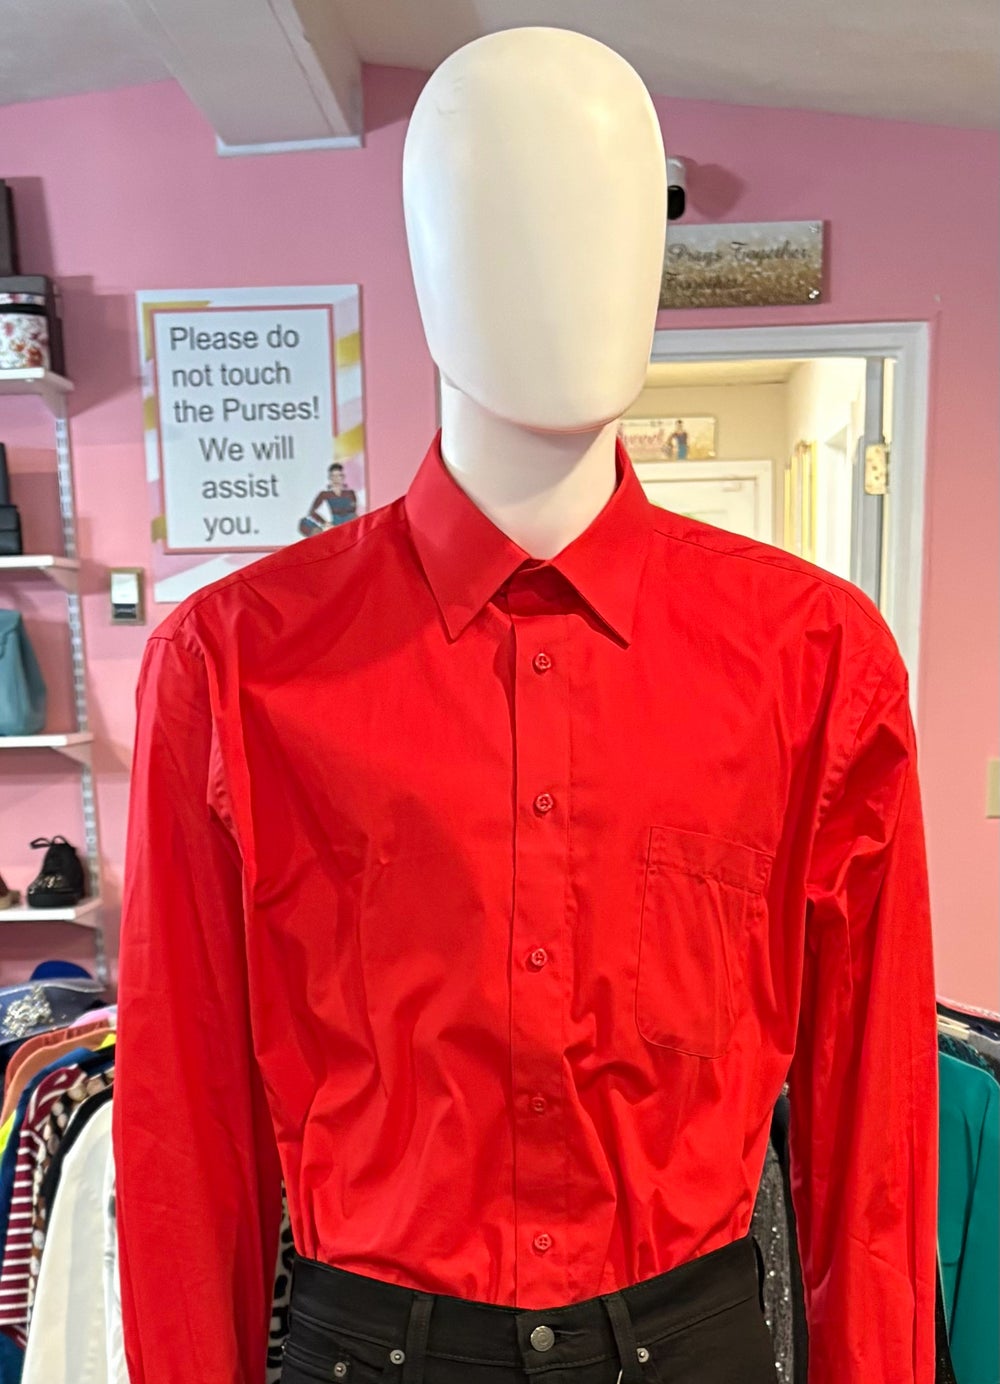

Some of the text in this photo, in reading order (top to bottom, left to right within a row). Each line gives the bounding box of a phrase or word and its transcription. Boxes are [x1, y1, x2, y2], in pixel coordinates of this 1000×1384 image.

[169, 324, 300, 351] Please do
[172, 361, 291, 388] not touch
[174, 396, 319, 423] the Purses!
[199, 436, 294, 462] We will
[202, 473, 279, 499] assist
[204, 513, 259, 541] you.
